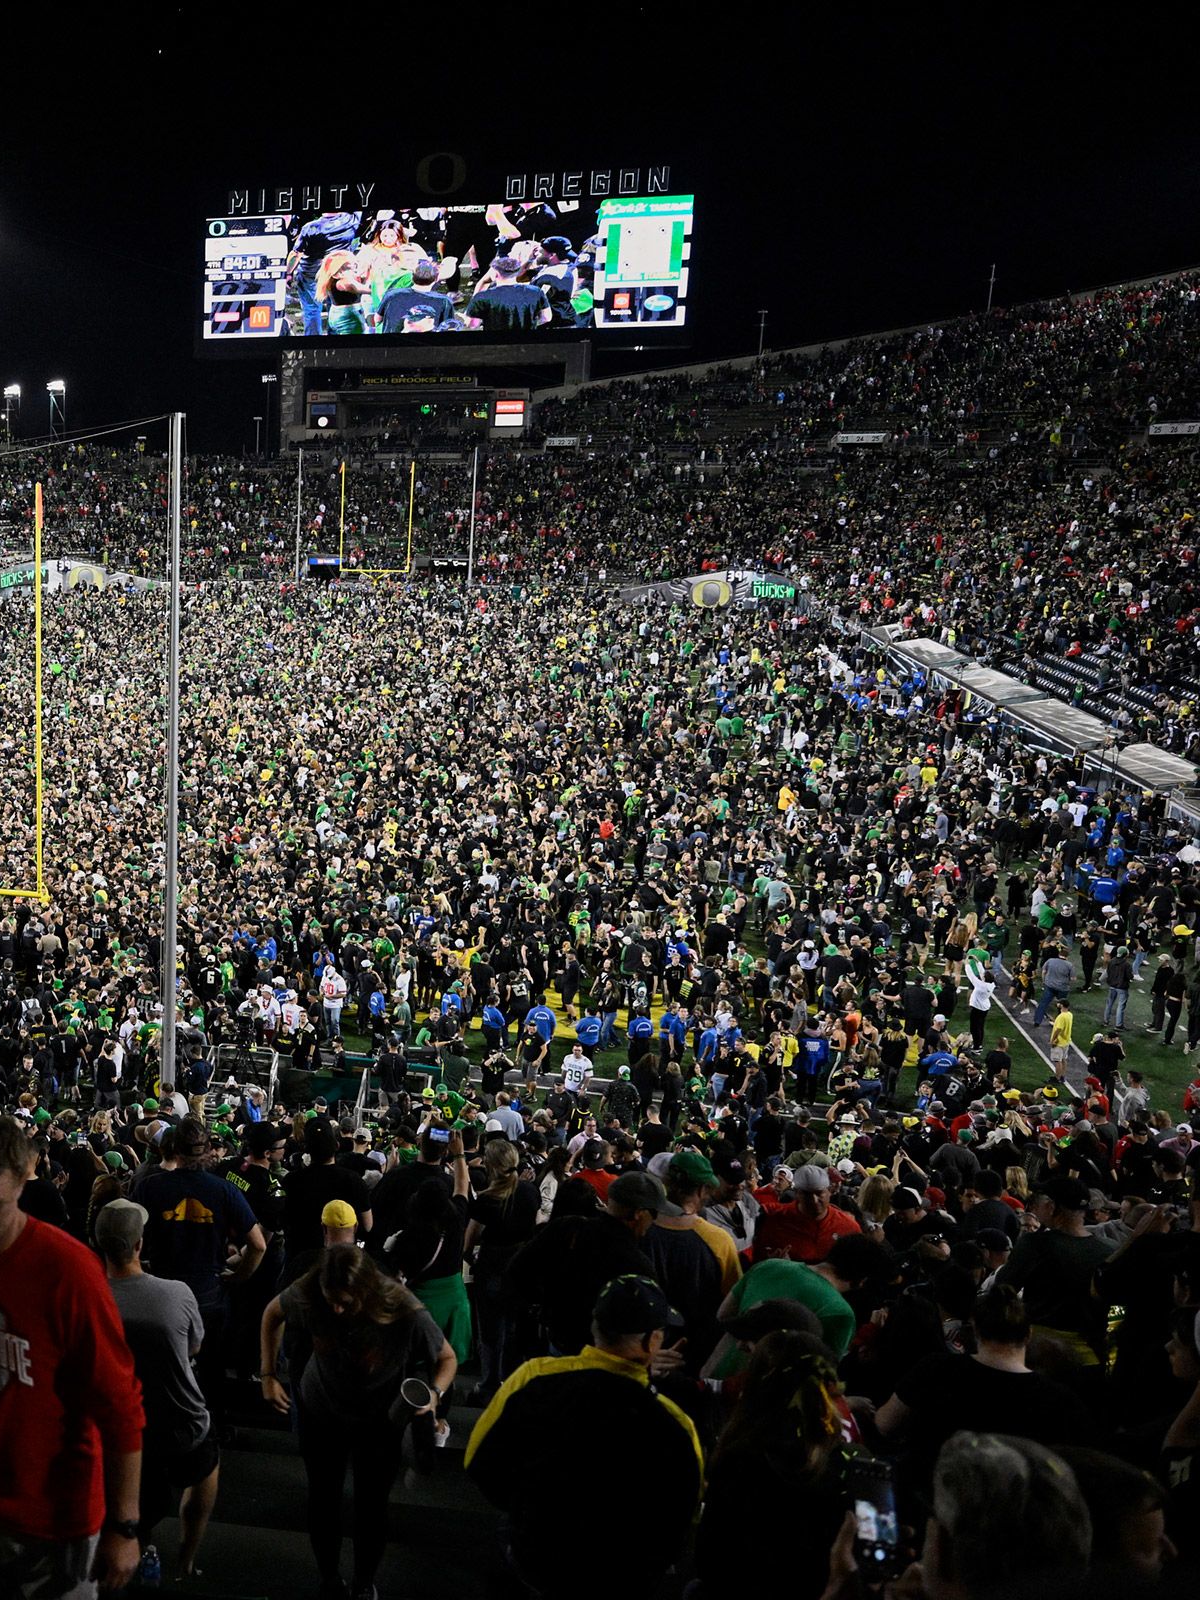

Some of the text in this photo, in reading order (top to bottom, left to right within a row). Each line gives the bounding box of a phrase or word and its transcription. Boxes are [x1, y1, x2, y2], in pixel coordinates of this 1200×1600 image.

[228, 166, 670, 215] MIGHTY OREGON
[264, 218, 283, 233] 32
[363, 375, 472, 384] RICH BROOKS FIELD
[0, 568, 47, 589] DUCKS-WN
[728, 571, 742, 582] 39
[692, 580, 732, 608] O
[91, 926, 101, 939] 10
[207, 970, 215, 984] 6
[61, 1040, 66, 1054] 1
[567, 1068, 582, 1083] 39
[946, 1081, 959, 1096] 8
[226, 1170, 252, 1192] OREGON
